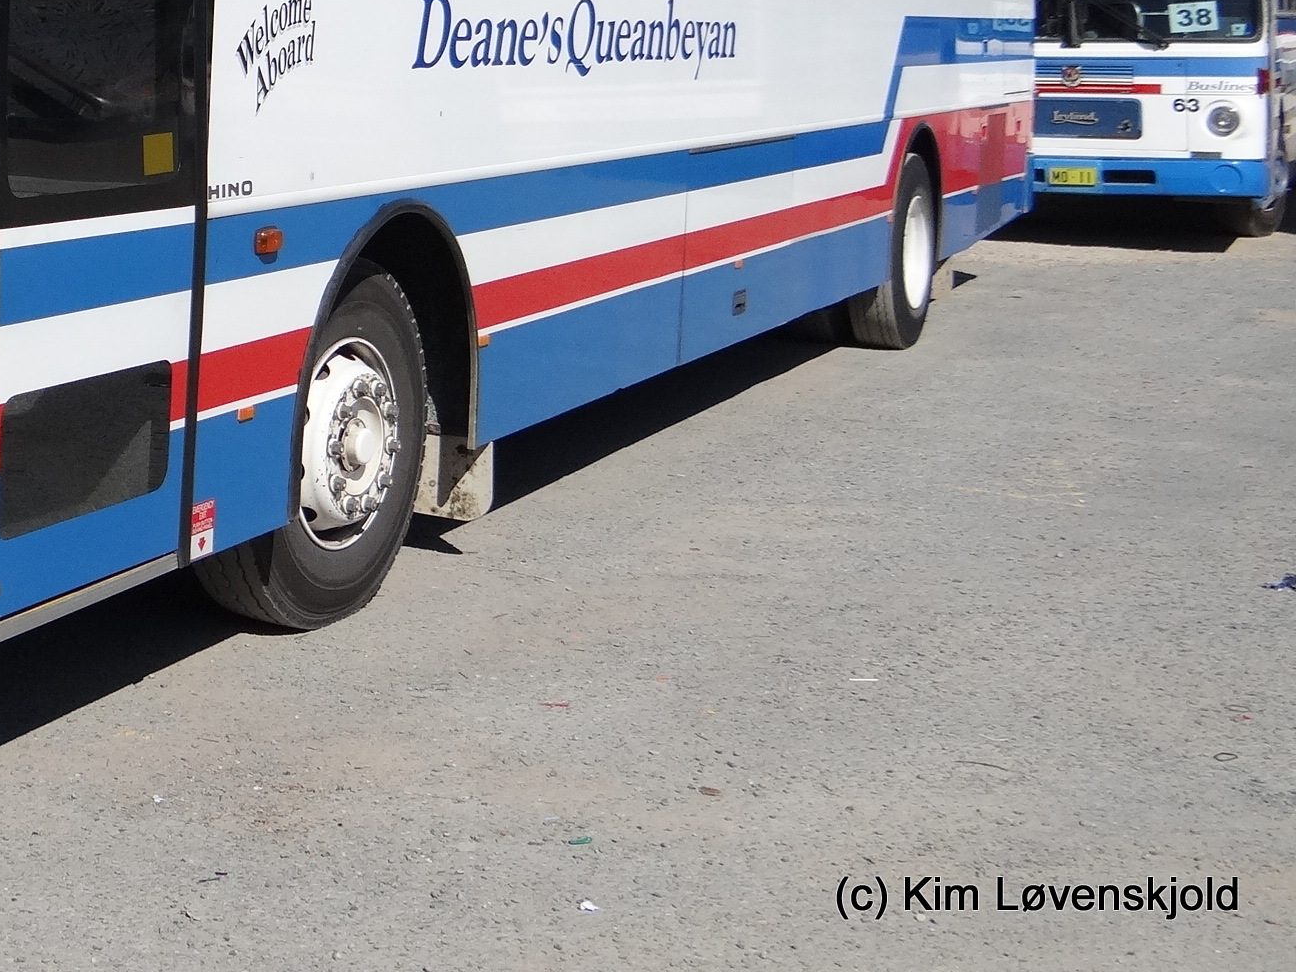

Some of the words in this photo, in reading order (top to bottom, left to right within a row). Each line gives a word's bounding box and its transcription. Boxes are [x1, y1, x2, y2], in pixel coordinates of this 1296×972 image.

[1177, 8, 1212, 28] 38
[255, 21, 316, 116] Aboard
[1187, 80, 1256, 91] Buslines
[1174, 97, 1200, 113] 63
[208, 180, 253, 200] HINO
